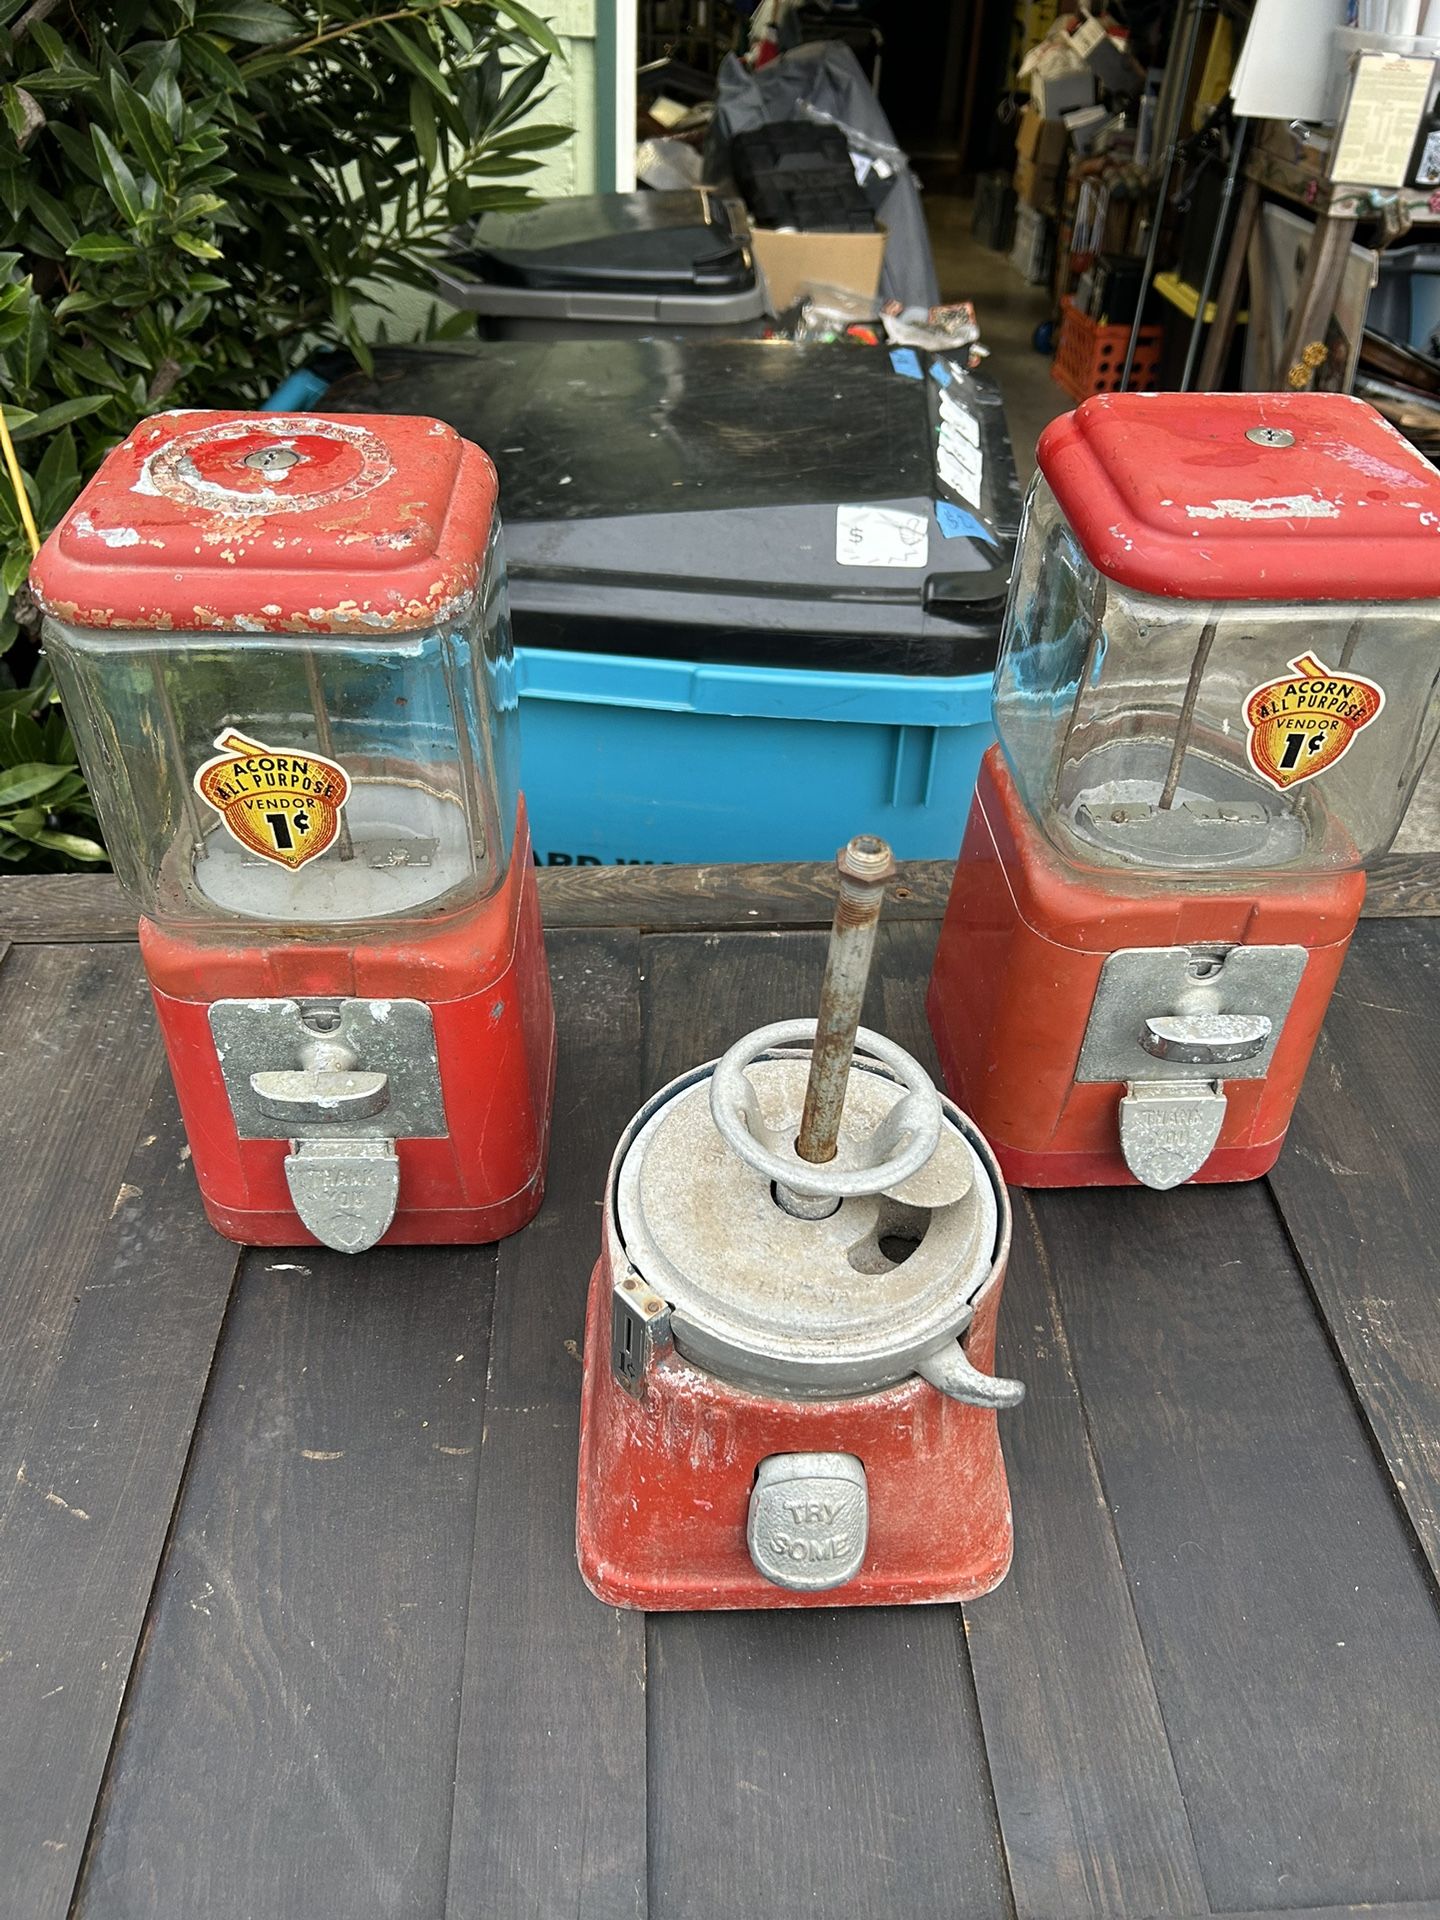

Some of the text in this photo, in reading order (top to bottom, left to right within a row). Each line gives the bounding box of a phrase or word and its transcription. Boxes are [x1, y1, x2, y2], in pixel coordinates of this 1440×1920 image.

[1284, 681, 1354, 699] ACORN
[1260, 695, 1367, 722] ALL PURPOSE
[1277, 718, 1339, 730] VENDOR
[1279, 731, 1326, 769] 1¢
[233, 757, 308, 777] ACORN
[215, 772, 336, 801] ALL PURPOSE
[244, 798, 316, 810] VENDOR
[265, 810, 310, 849] 1¢
[783, 1499, 848, 1526] TRY
[769, 1532, 852, 1563] SOME
